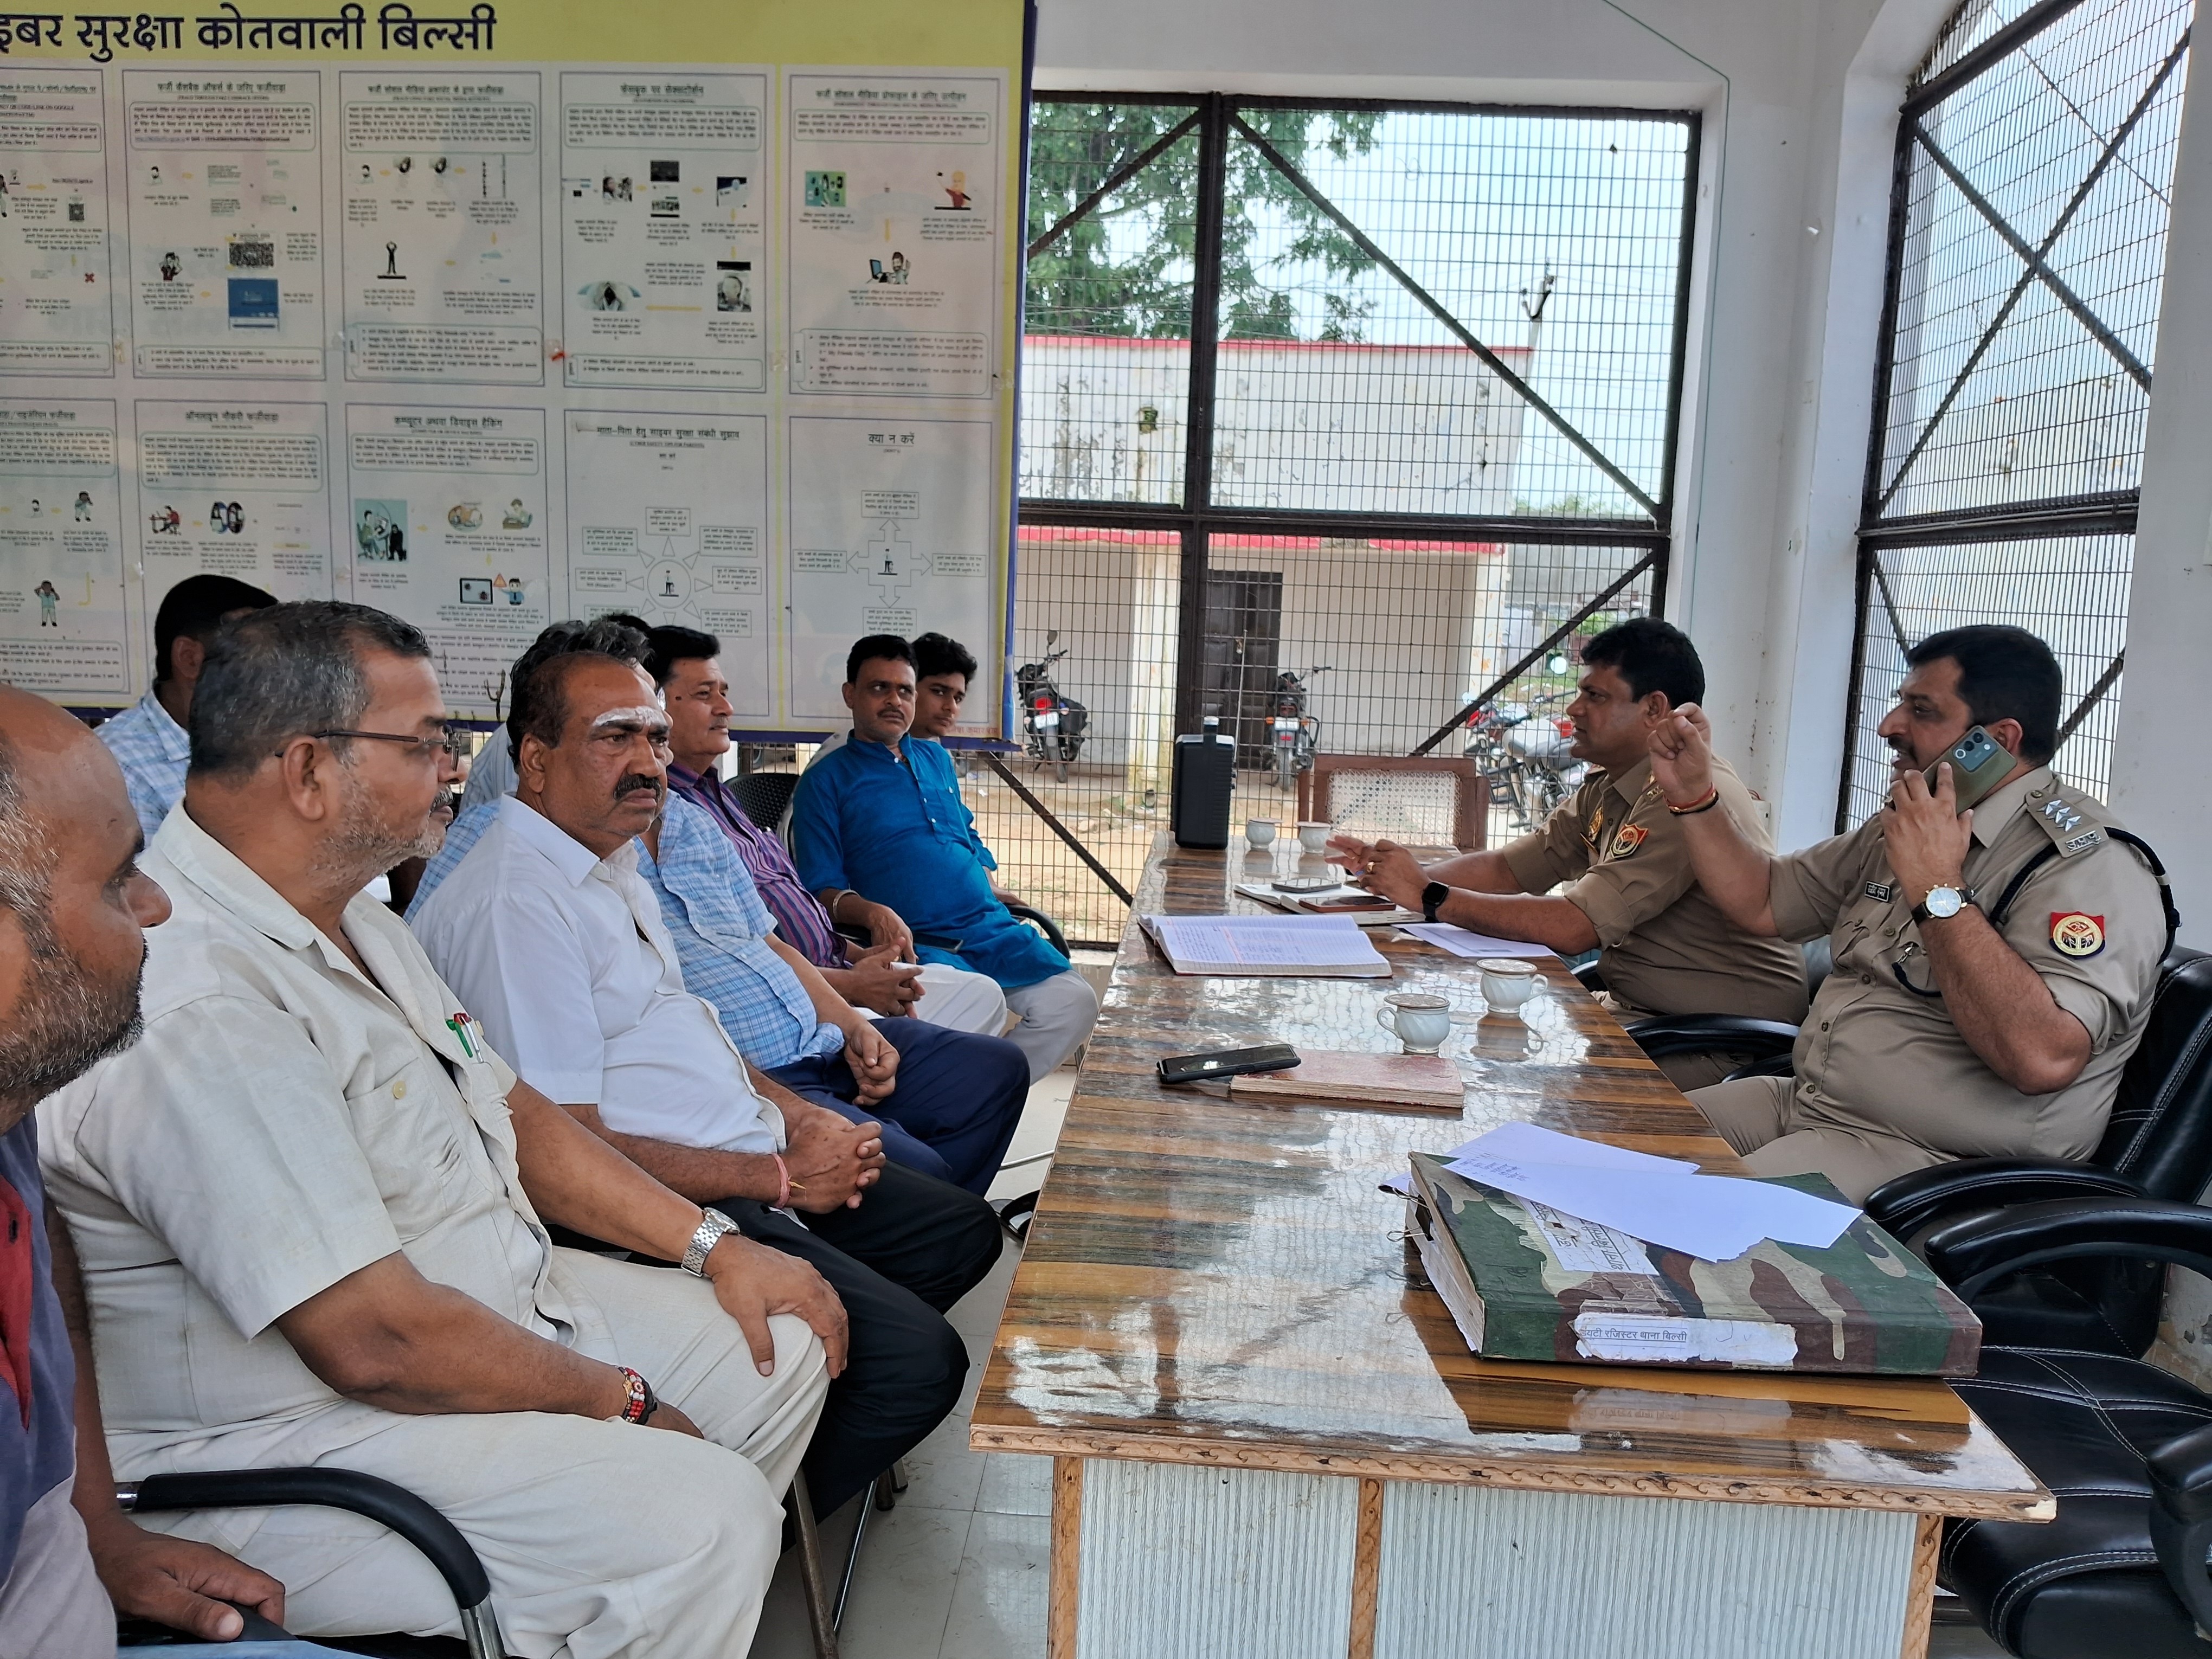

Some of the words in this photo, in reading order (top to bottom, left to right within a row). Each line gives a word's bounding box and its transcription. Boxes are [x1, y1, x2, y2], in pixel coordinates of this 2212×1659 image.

[74, 13, 185, 63] सुरक्षा
[196, 3, 366, 50] कोतवाली
[378, 3, 497, 50] बिल्सी
[868, 434, 884, 443] क्या
[889, 435, 896, 443] न
[1605, 1328, 1638, 1339] रजिस्टर
[1640, 1331, 1660, 1340] थाना
[1663, 1330, 1687, 1341] बिल्सी
